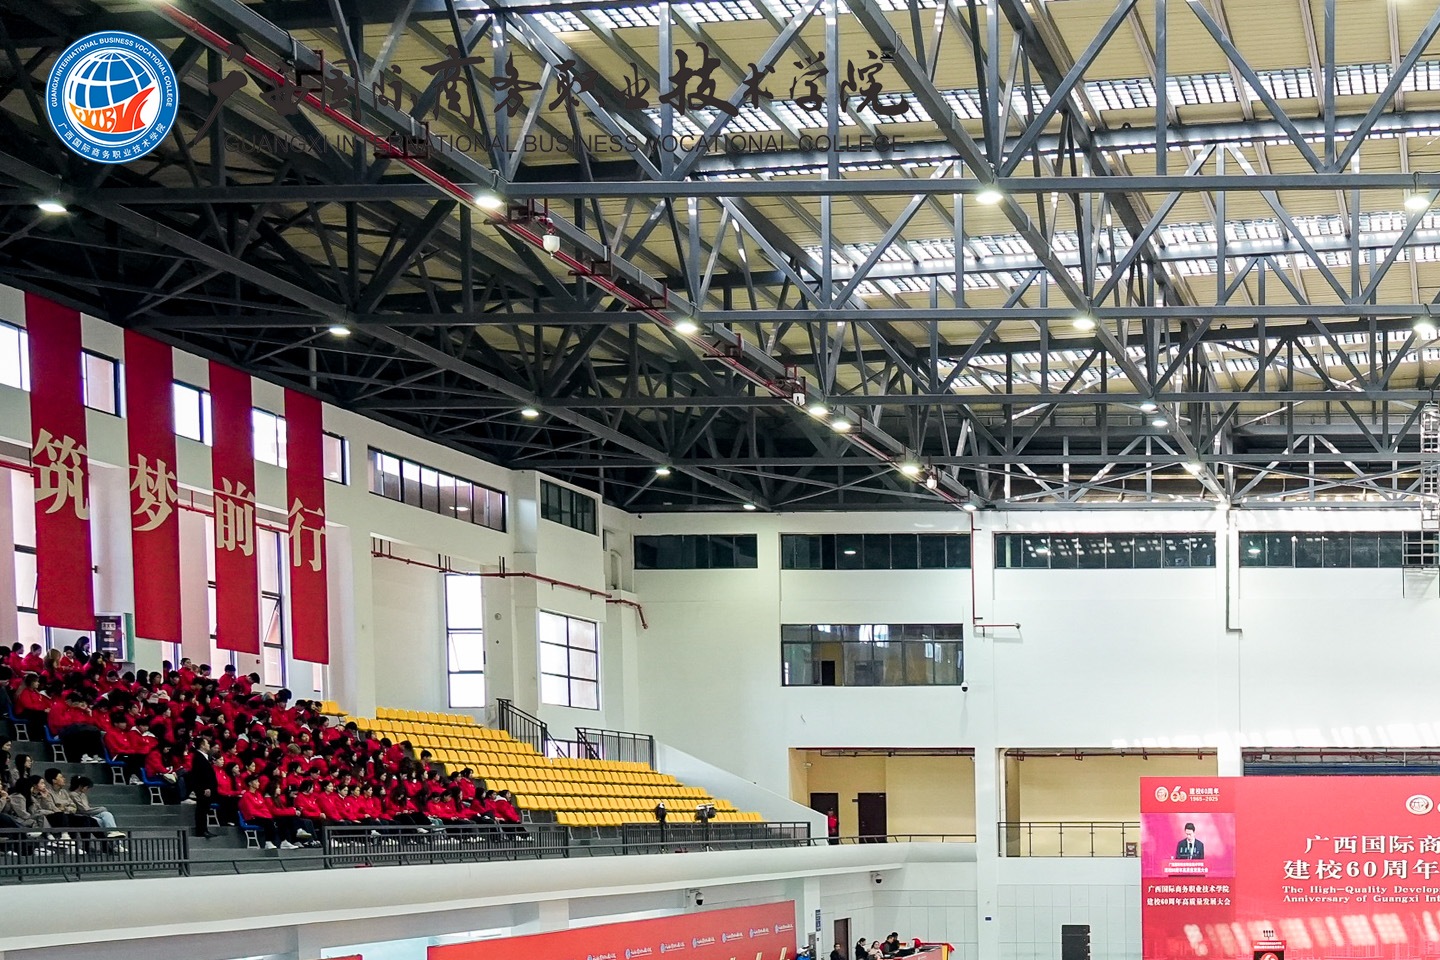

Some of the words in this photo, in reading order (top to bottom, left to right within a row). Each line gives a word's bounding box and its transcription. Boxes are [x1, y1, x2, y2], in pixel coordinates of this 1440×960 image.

[1148, 885, 1230, 893] 广西国际商务职业技术学院
[1310, 886, 1387, 895] High-Quality
[1147, 898, 1231, 906] 建校60周年高质量发展大会
[1283, 895, 1350, 903] Anniversary
[1373, 895, 1419, 903] Guangxi
